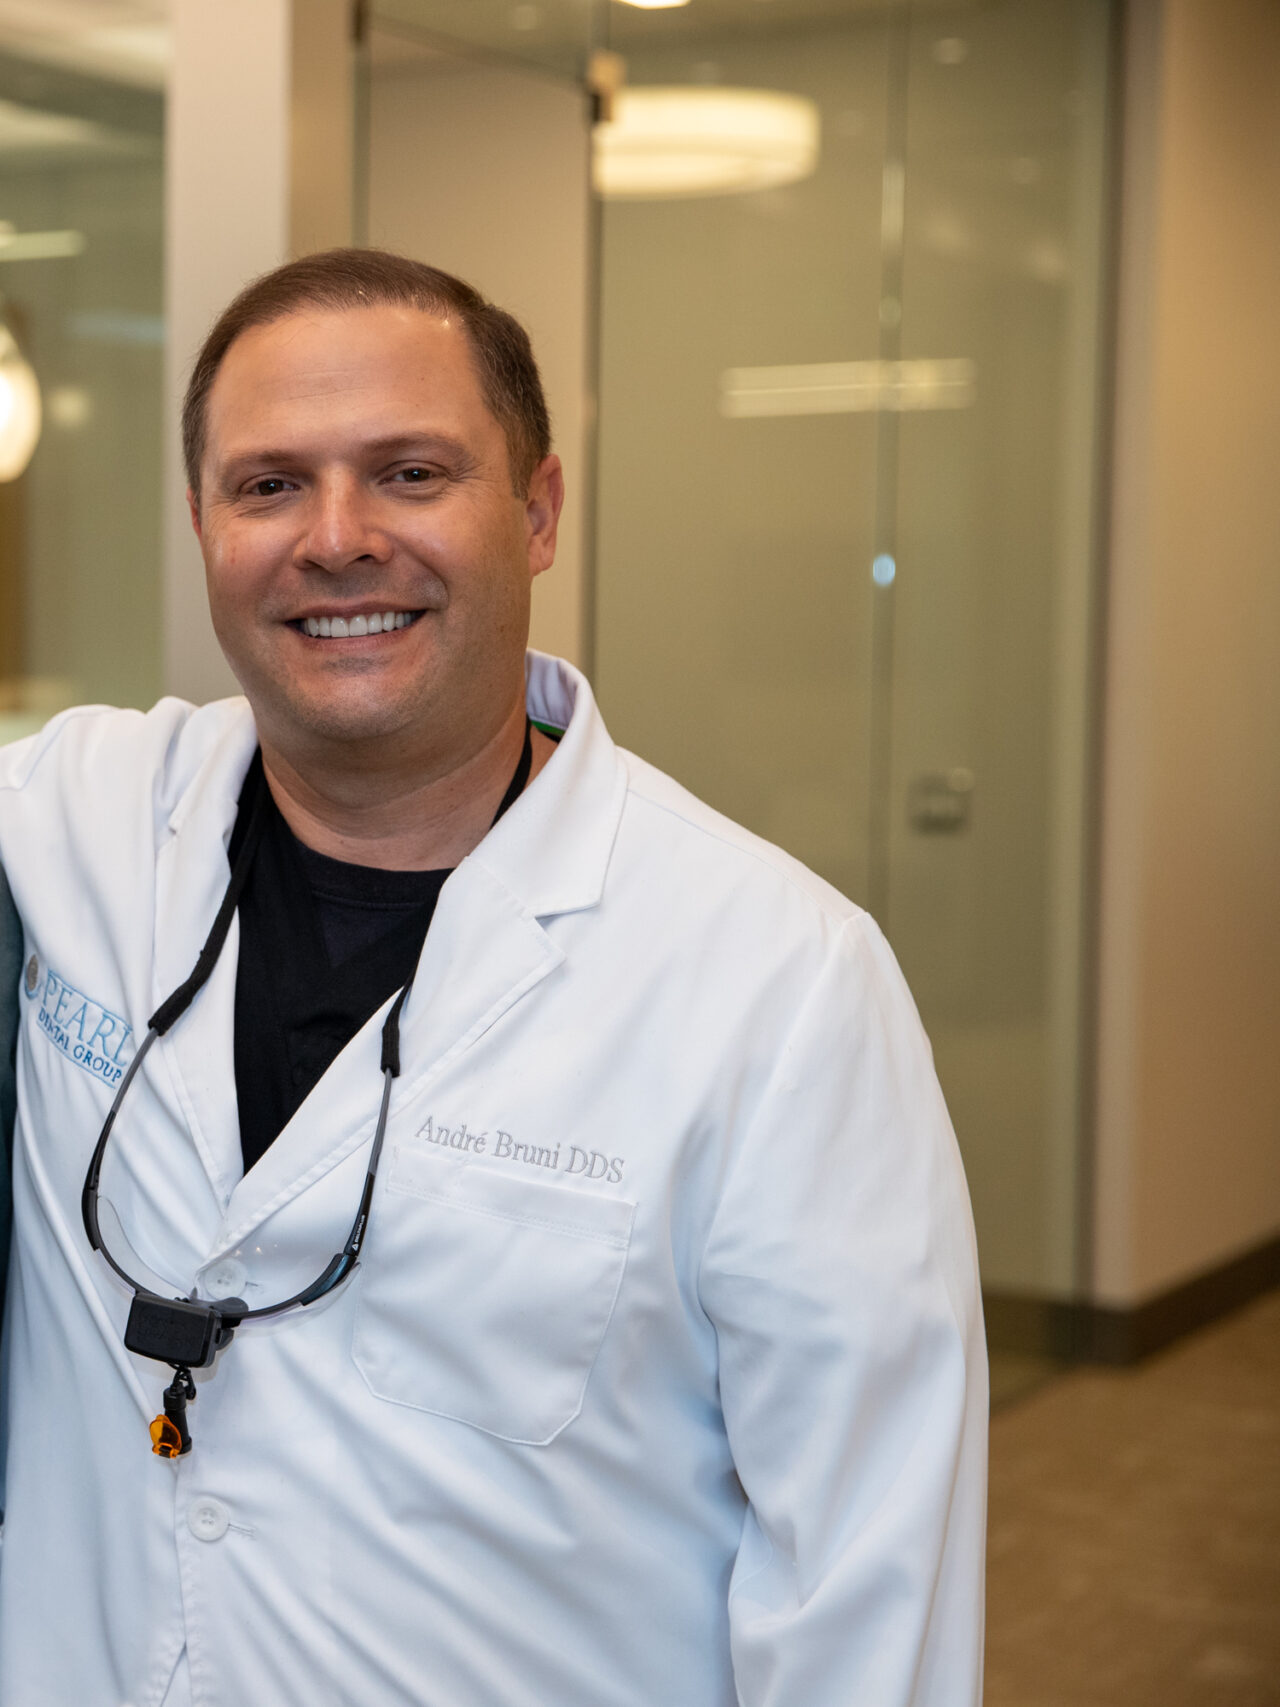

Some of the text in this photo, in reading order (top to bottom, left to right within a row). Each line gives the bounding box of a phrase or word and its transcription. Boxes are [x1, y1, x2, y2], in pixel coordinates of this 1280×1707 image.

[38, 1006, 122, 1083] DENTAL GROUP
[42, 970, 133, 1067] PEARL
[414, 1115, 625, 1184] André Bruni DDS
